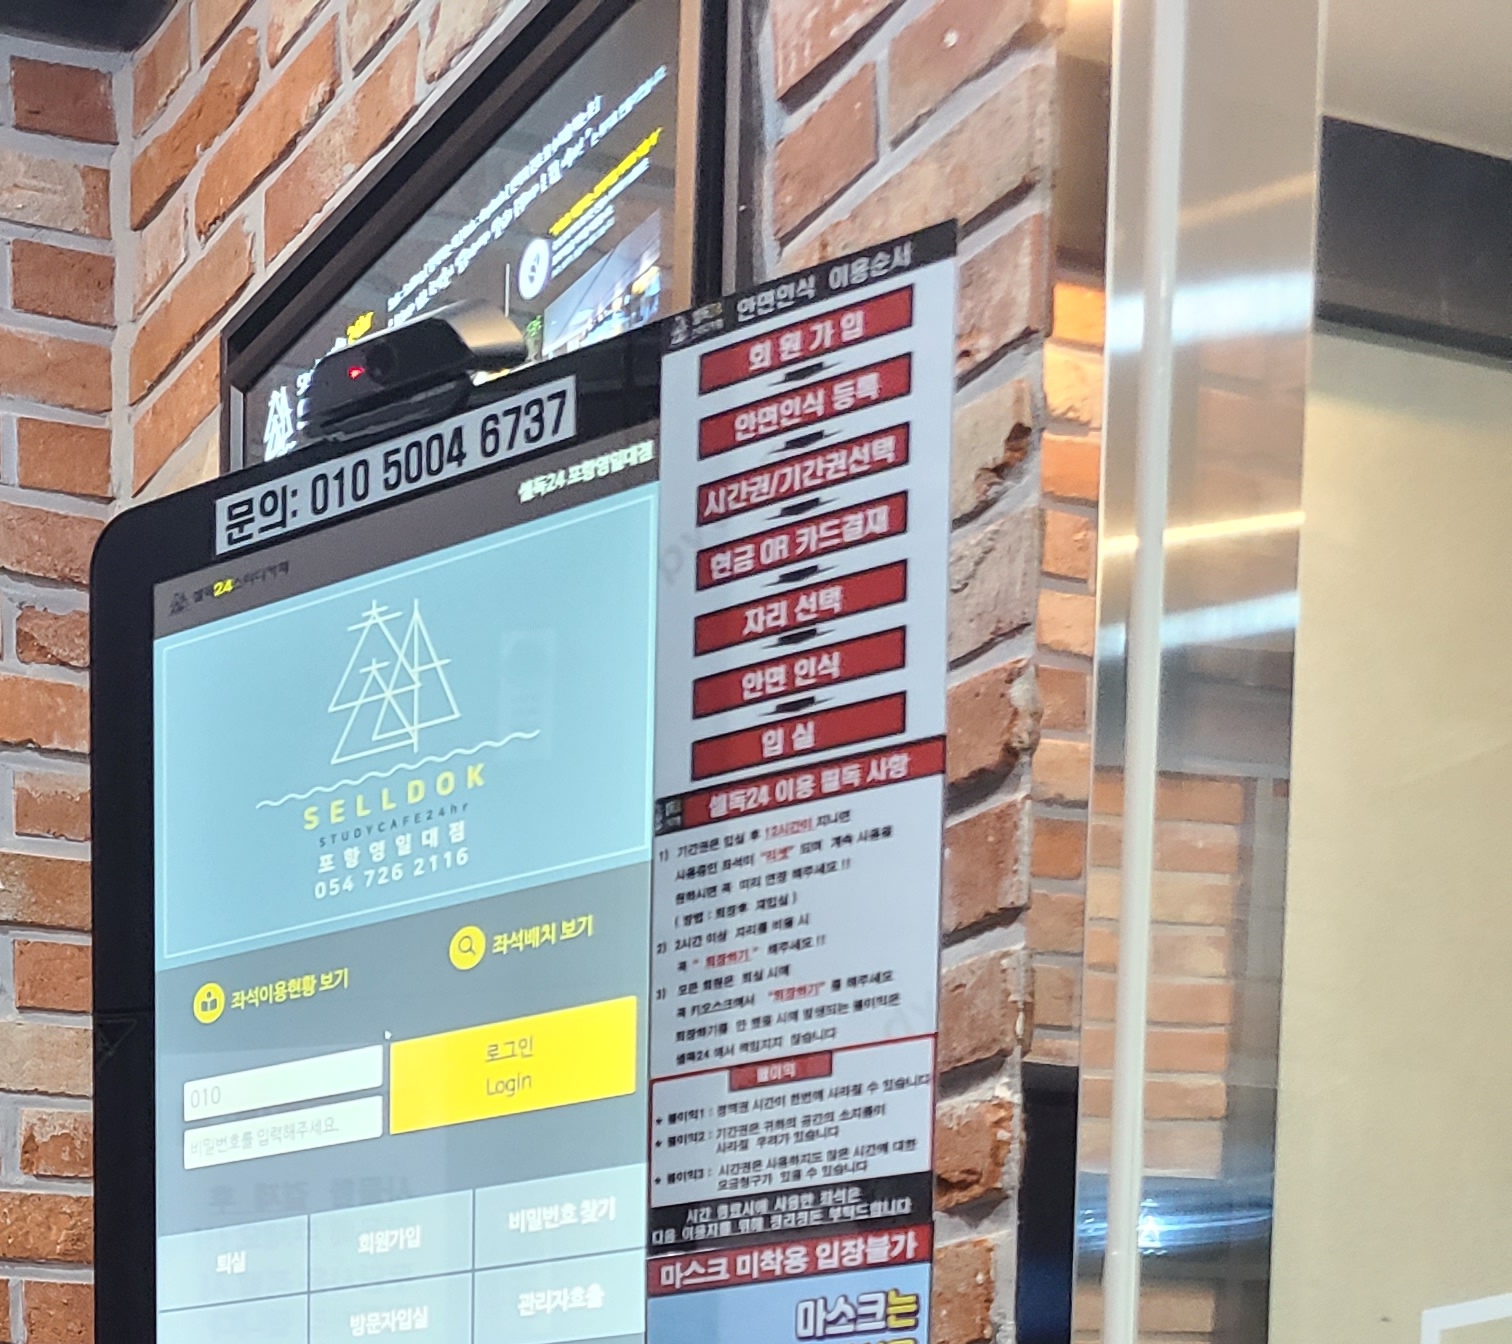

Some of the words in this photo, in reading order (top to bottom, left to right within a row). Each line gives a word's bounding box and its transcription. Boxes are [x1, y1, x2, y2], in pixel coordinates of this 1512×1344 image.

[737, 275, 815, 322] 안면인식
[828, 240, 912, 290] 이용순서
[734, 388, 824, 441] 안면인식
[832, 372, 882, 410] 등록
[311, 459, 369, 516] 010
[383, 427, 466, 488] 5004
[480, 390, 568, 459] 6737
[710, 542, 755, 581] 현금
[760, 533, 789, 560] OR
[742, 607, 787, 636] 자리
[794, 585, 843, 623] 선택
[742, 665, 786, 701] 안면
[794, 651, 841, 687] 인식
[303, 763, 487, 831] SELLDOK
[775, 777, 815, 803] 이용
[821, 765, 861, 794] 필독
[867, 753, 910, 782] 사항
[314, 877, 355, 900] 054
[364, 862, 404, 889] 726
[413, 847, 470, 876] 2116
[491, 921, 556, 955] 좌석배치
[559, 914, 594, 940] 보기
[230, 975, 317, 1011] 좌석이용현황
[319, 967, 350, 991] 보기
[484, 1036, 535, 1063] 로그인
[190, 1085, 222, 1110] 010
[485, 1071, 533, 1098] Login
[358, 1225, 422, 1255] 회원가입
[508, 1205, 579, 1234] 비밀번호
[580, 1196, 617, 1225] 찾기
[215, 1251, 247, 1275] 퇴실
[660, 1255, 729, 1288] 마스크
[736, 1244, 809, 1280] 미착용
[815, 1230, 918, 1270] 입장불가
[796, 1289, 919, 1340] 마스크는
